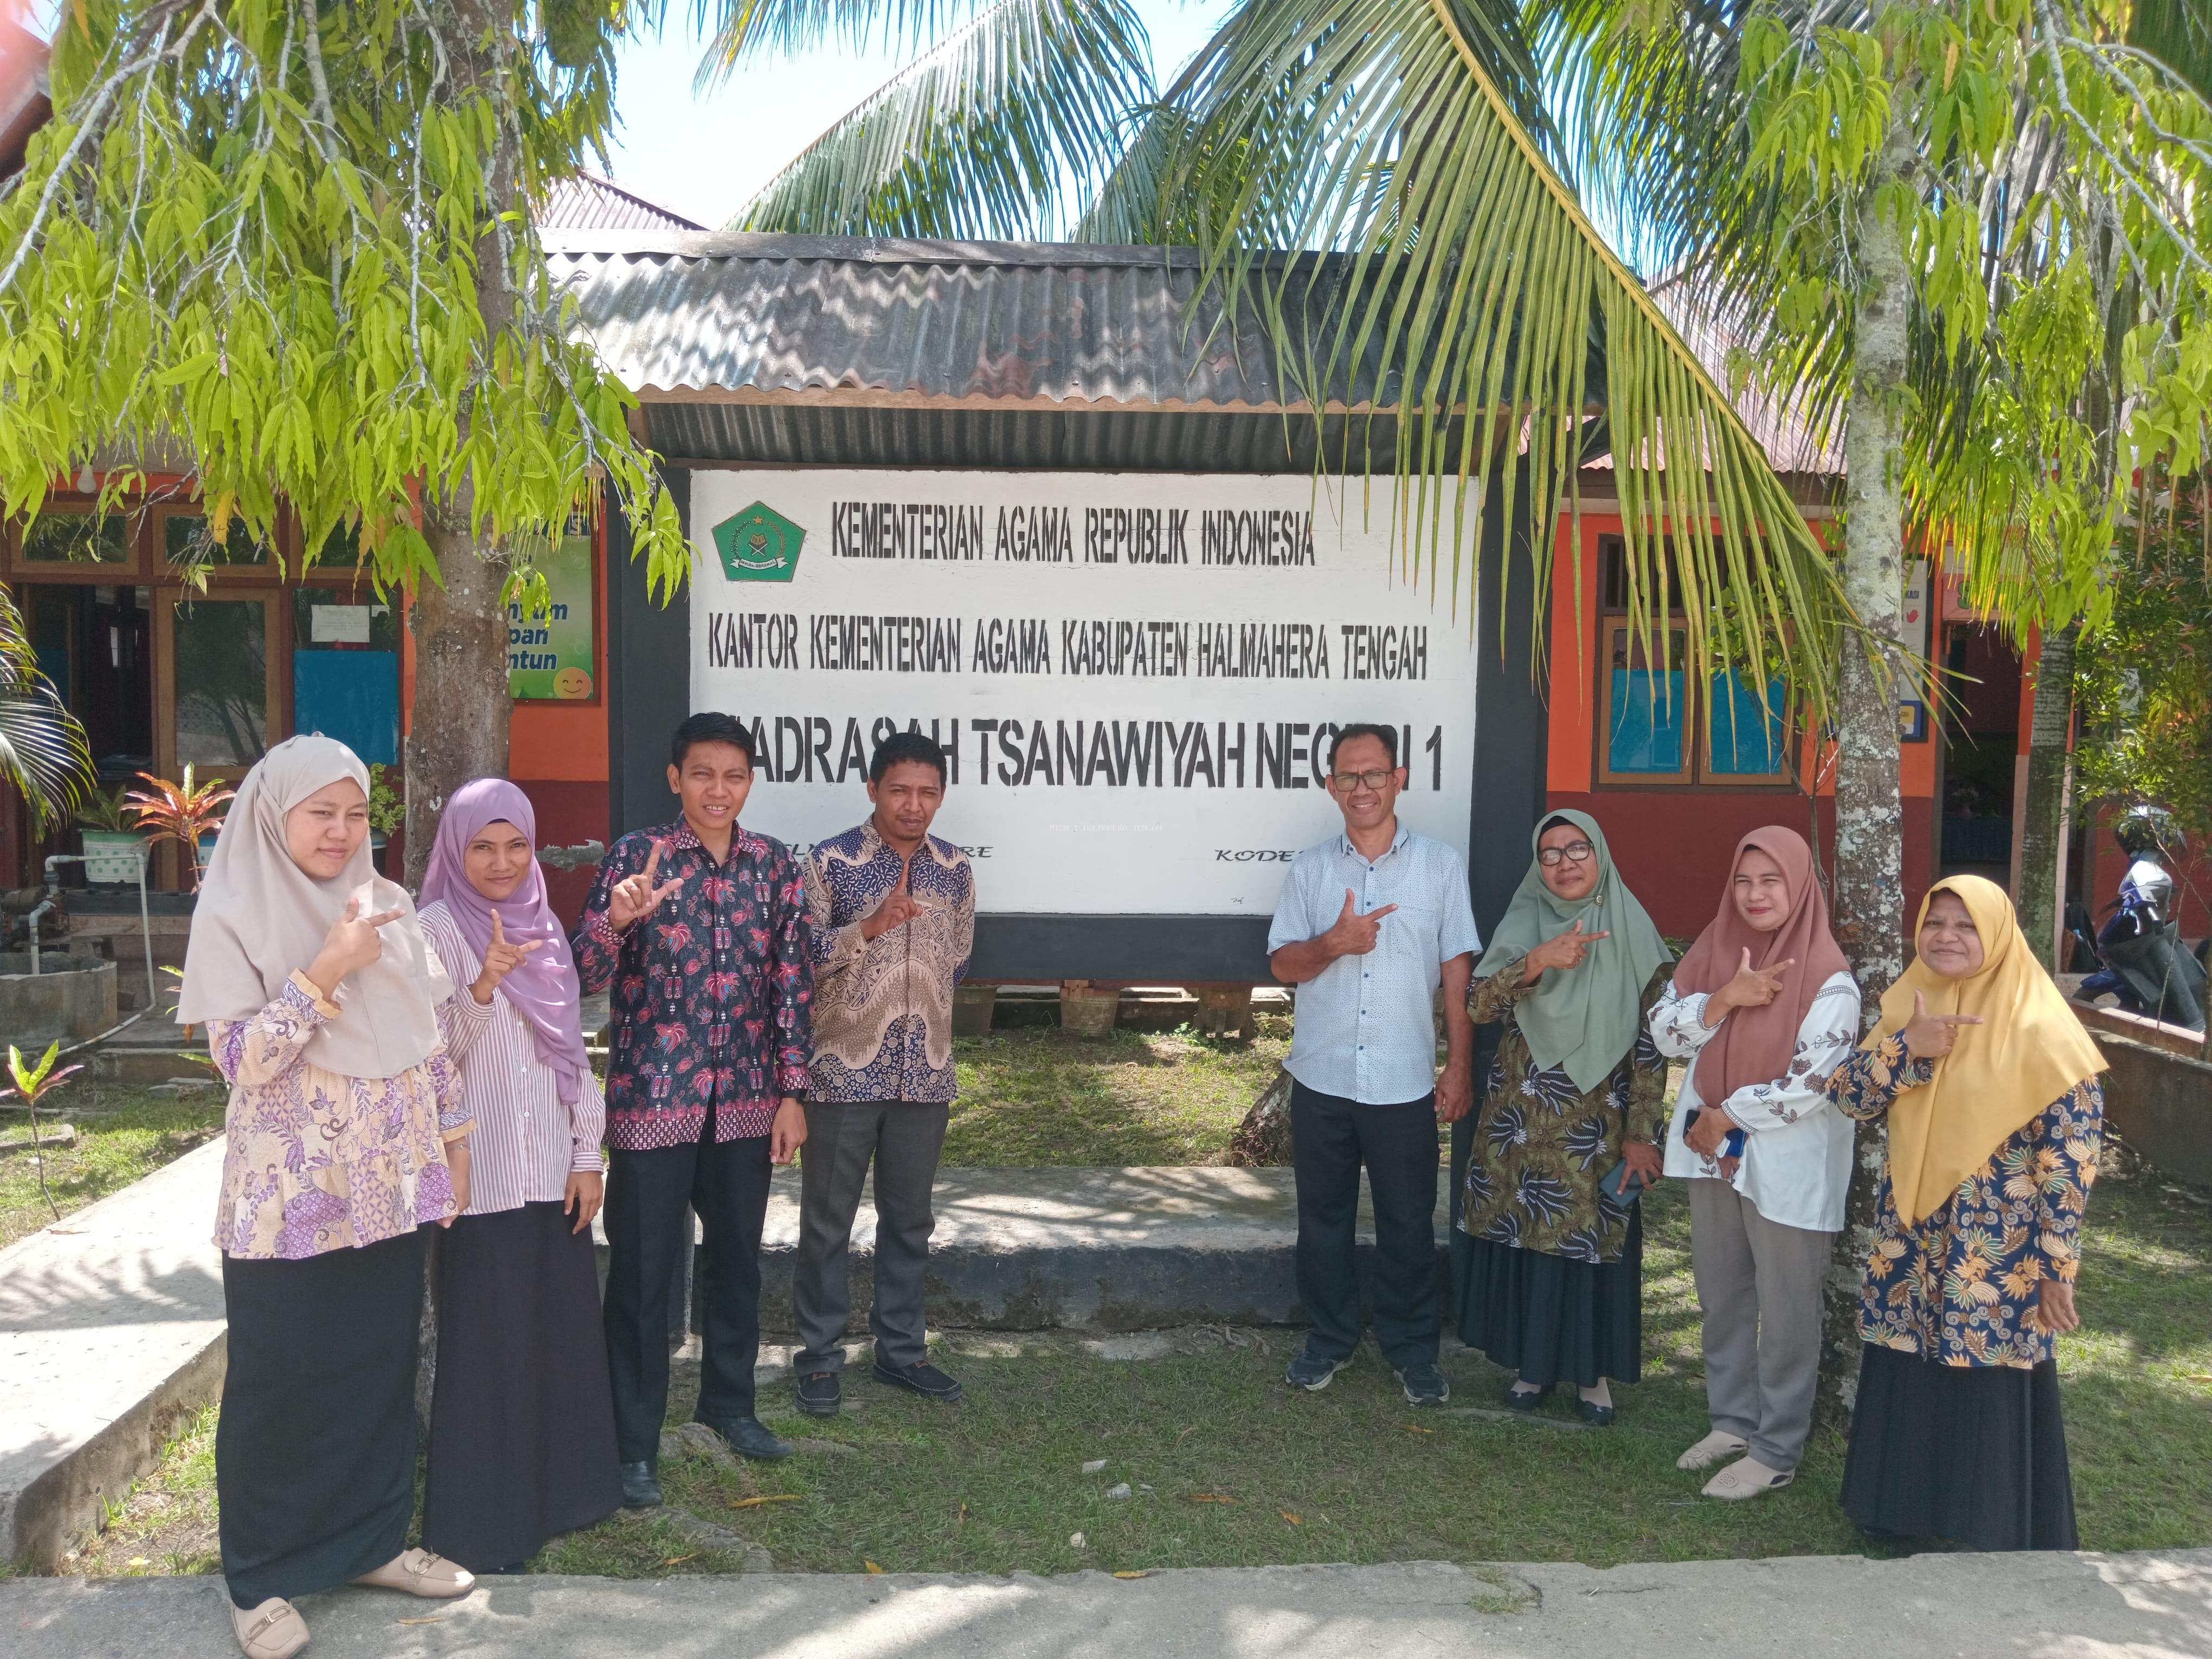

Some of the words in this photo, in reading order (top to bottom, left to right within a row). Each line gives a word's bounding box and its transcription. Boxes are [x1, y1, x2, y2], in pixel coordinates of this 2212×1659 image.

[832, 501, 983, 560] KEMENTERIAN
[994, 505, 1073, 562] AGAMA
[1085, 507, 1189, 564] REPUBLIK
[1201, 510, 1315, 566] INDONESIA
[709, 613, 799, 669] KANTOR
[811, 615, 961, 672] KEMENTERIAN
[972, 618, 1051, 674] AGAMA
[1062, 620, 1188, 676] KABUPATEN
[1198, 622, 1329, 679] HALMAHERA
[1342, 625, 1427, 680] TENGAH
[729, 716, 959, 785] ADRAH
[972, 718, 1245, 787] TSANAWIYAH
[1426, 725, 1442, 791] 1
[1214, 850, 1295, 862] KODE
